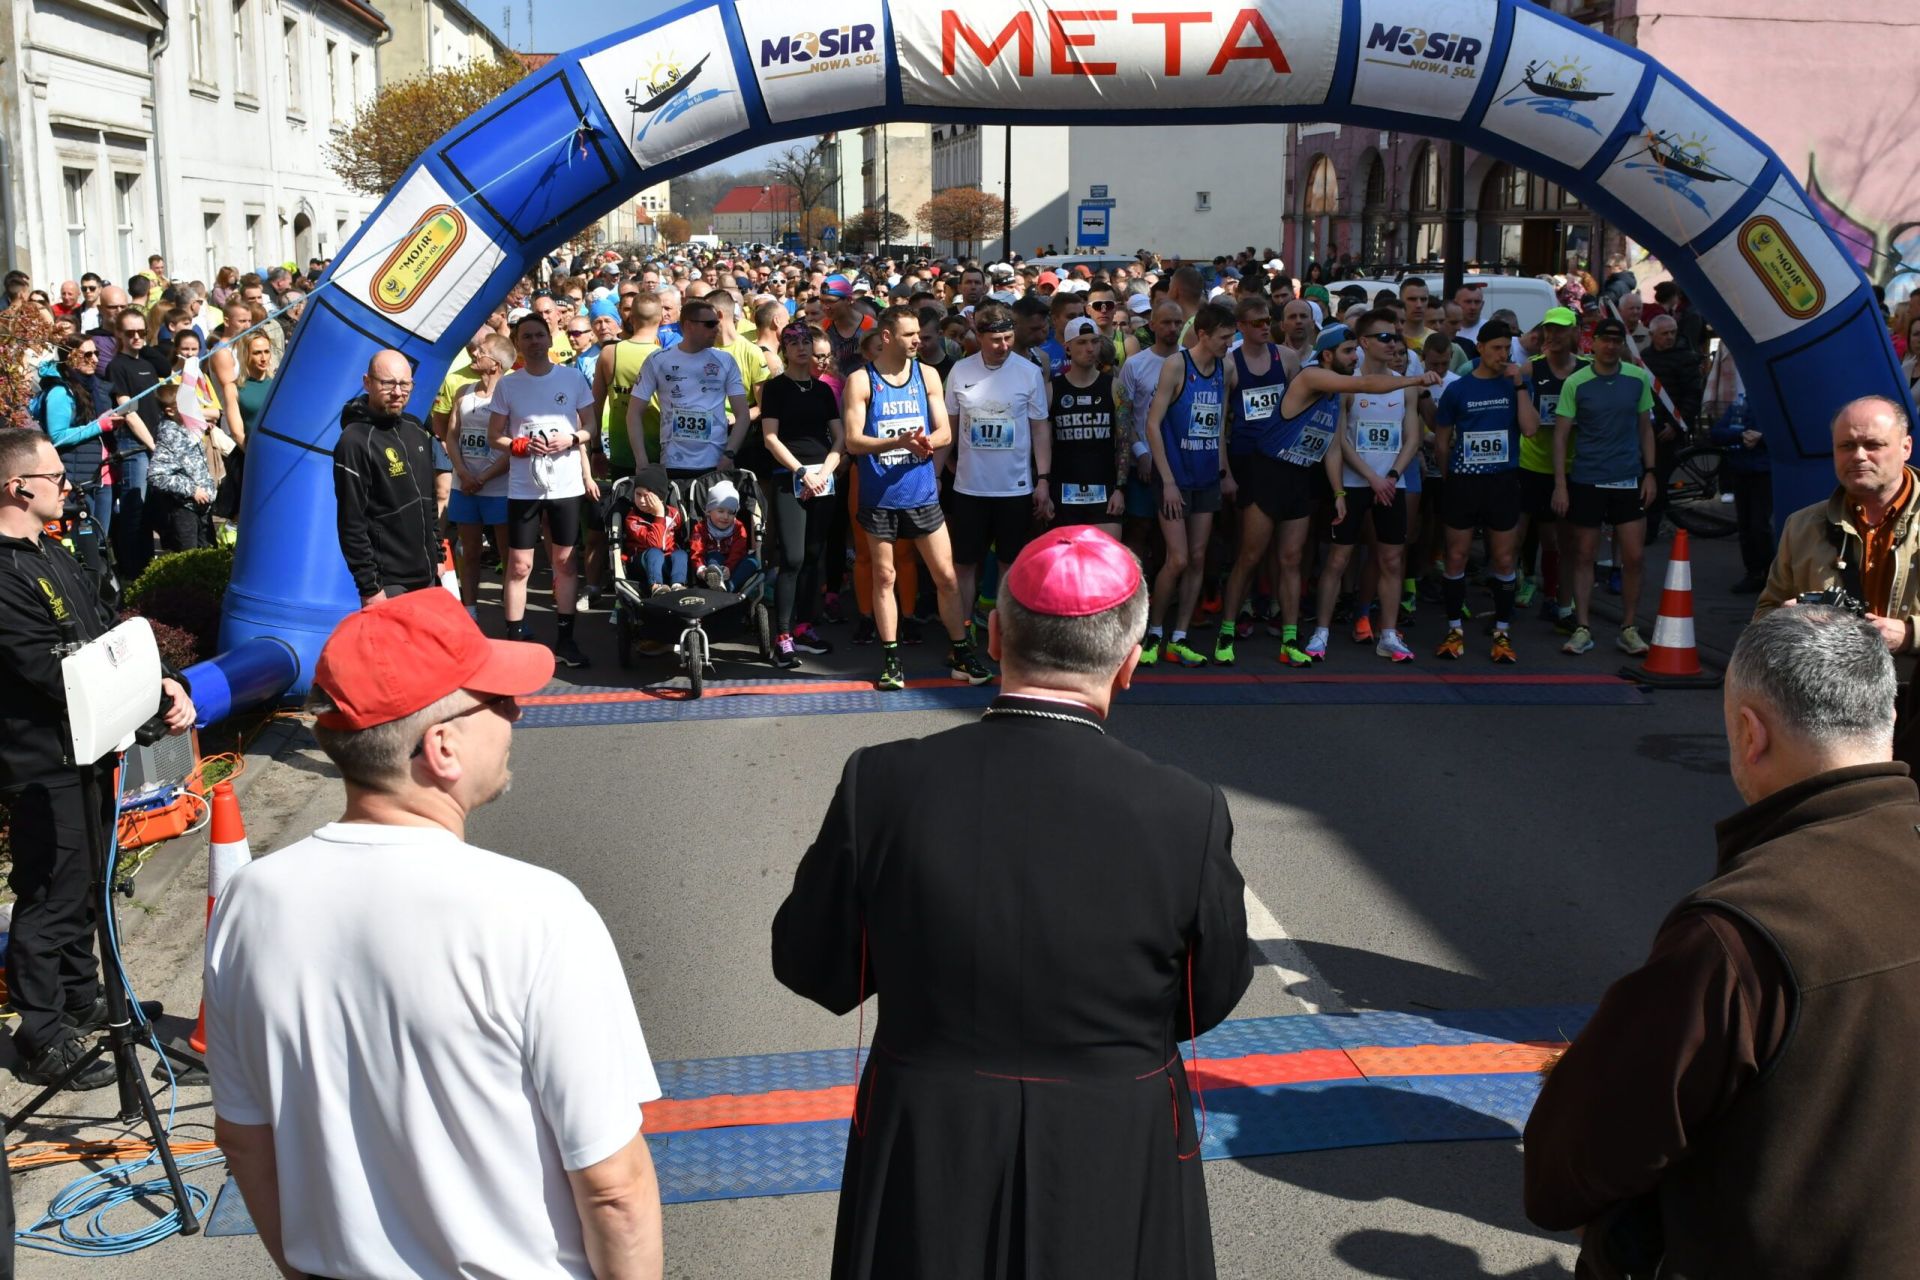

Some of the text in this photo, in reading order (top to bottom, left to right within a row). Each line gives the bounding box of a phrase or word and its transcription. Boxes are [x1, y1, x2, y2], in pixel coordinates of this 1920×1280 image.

[761, 23, 876, 67] MOSiR
[941, 8, 1292, 77] META
[1366, 22, 1482, 65] MOSiR
[810, 57, 851, 73] NOWA
[1409, 59, 1449, 75] NOWA
[1546, 71, 1568, 89] Nowa
[646, 81, 671, 98] Nowa
[413, 255, 430, 273] NOWA
[882, 400, 921, 416] ASTRA
[1251, 392, 1280, 408] 430
[1467, 397, 1509, 408] Streamsoft
[678, 415, 707, 431] 333
[1056, 413, 1110, 427] SEKCJA
[980, 424, 1003, 438] 177
[1369, 428, 1389, 442] 89
[1181, 438, 1204, 450] NOWA
[1301, 434, 1325, 450] 219
[1471, 439, 1502, 453] 496
